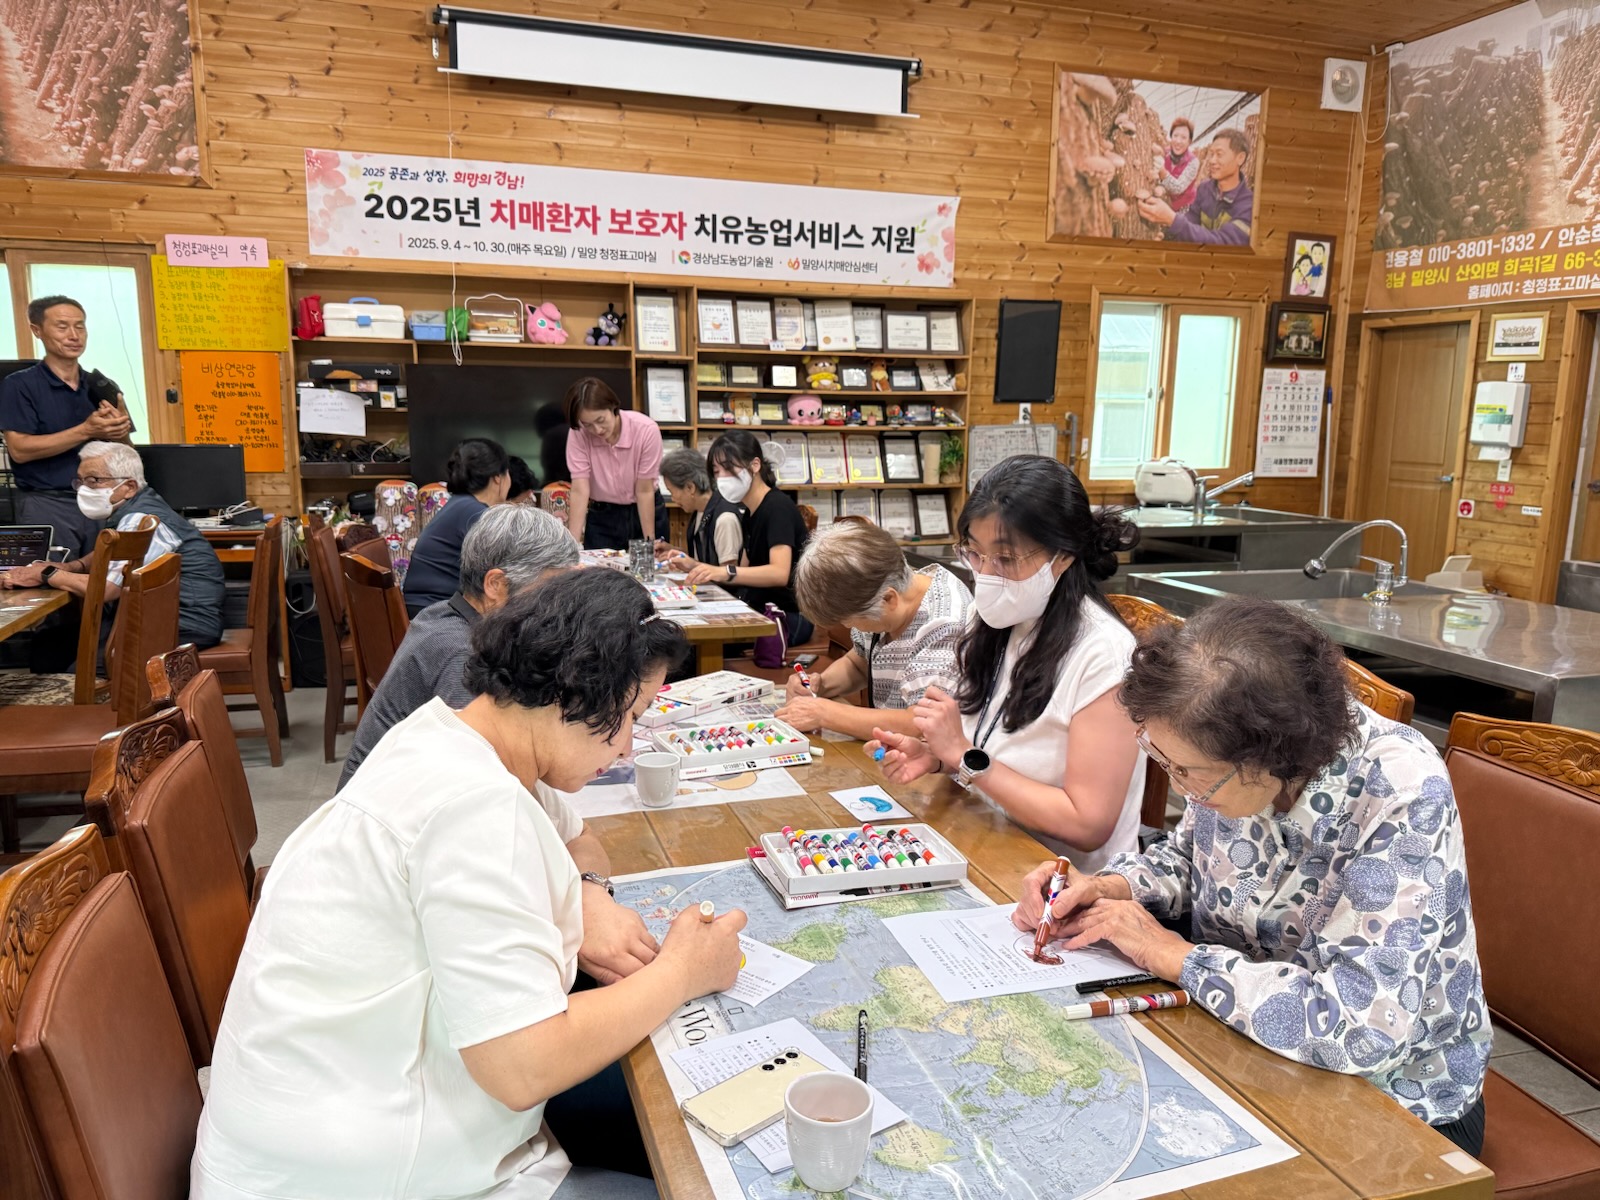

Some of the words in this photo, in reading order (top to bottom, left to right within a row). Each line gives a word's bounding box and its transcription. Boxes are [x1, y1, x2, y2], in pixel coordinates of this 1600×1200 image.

[362, 167, 385, 178] 2025
[388, 166, 420, 181] 공존과
[423, 170, 448, 183] 성장,
[453, 170, 492, 186] 희망의
[494, 171, 525, 190] 경남!
[364, 194, 482, 228] 2025년
[490, 199, 602, 236] 치매환자
[608, 206, 688, 242] 보호자
[694, 214, 864, 250] 치유농업서비스
[871, 225, 916, 254] 지원
[172, 240, 229, 260] 청정표고마실의
[534, 244, 567, 258] 목요일)
[578, 247, 598, 259] 밀양
[599, 248, 657, 264] 청정표고마실
[1428, 232, 1536, 264] 010-3801-1332
[1540, 230, 1554, 250] /
[692, 252, 774, 268] 경상남도농업기술원
[801, 258, 878, 274] 밀양시치매안심센터
[1386, 271, 1406, 288] 경남
[1411, 266, 1450, 287] 밀양시
[1456, 260, 1500, 282] 산외면
[1503, 254, 1558, 276] 희곡1길
[1468, 281, 1514, 300] 홈페이지
[201, 363, 256, 378] 비상연락망
[1290, 371, 1298, 383] 9
[198, 414, 215, 422] 소방서
